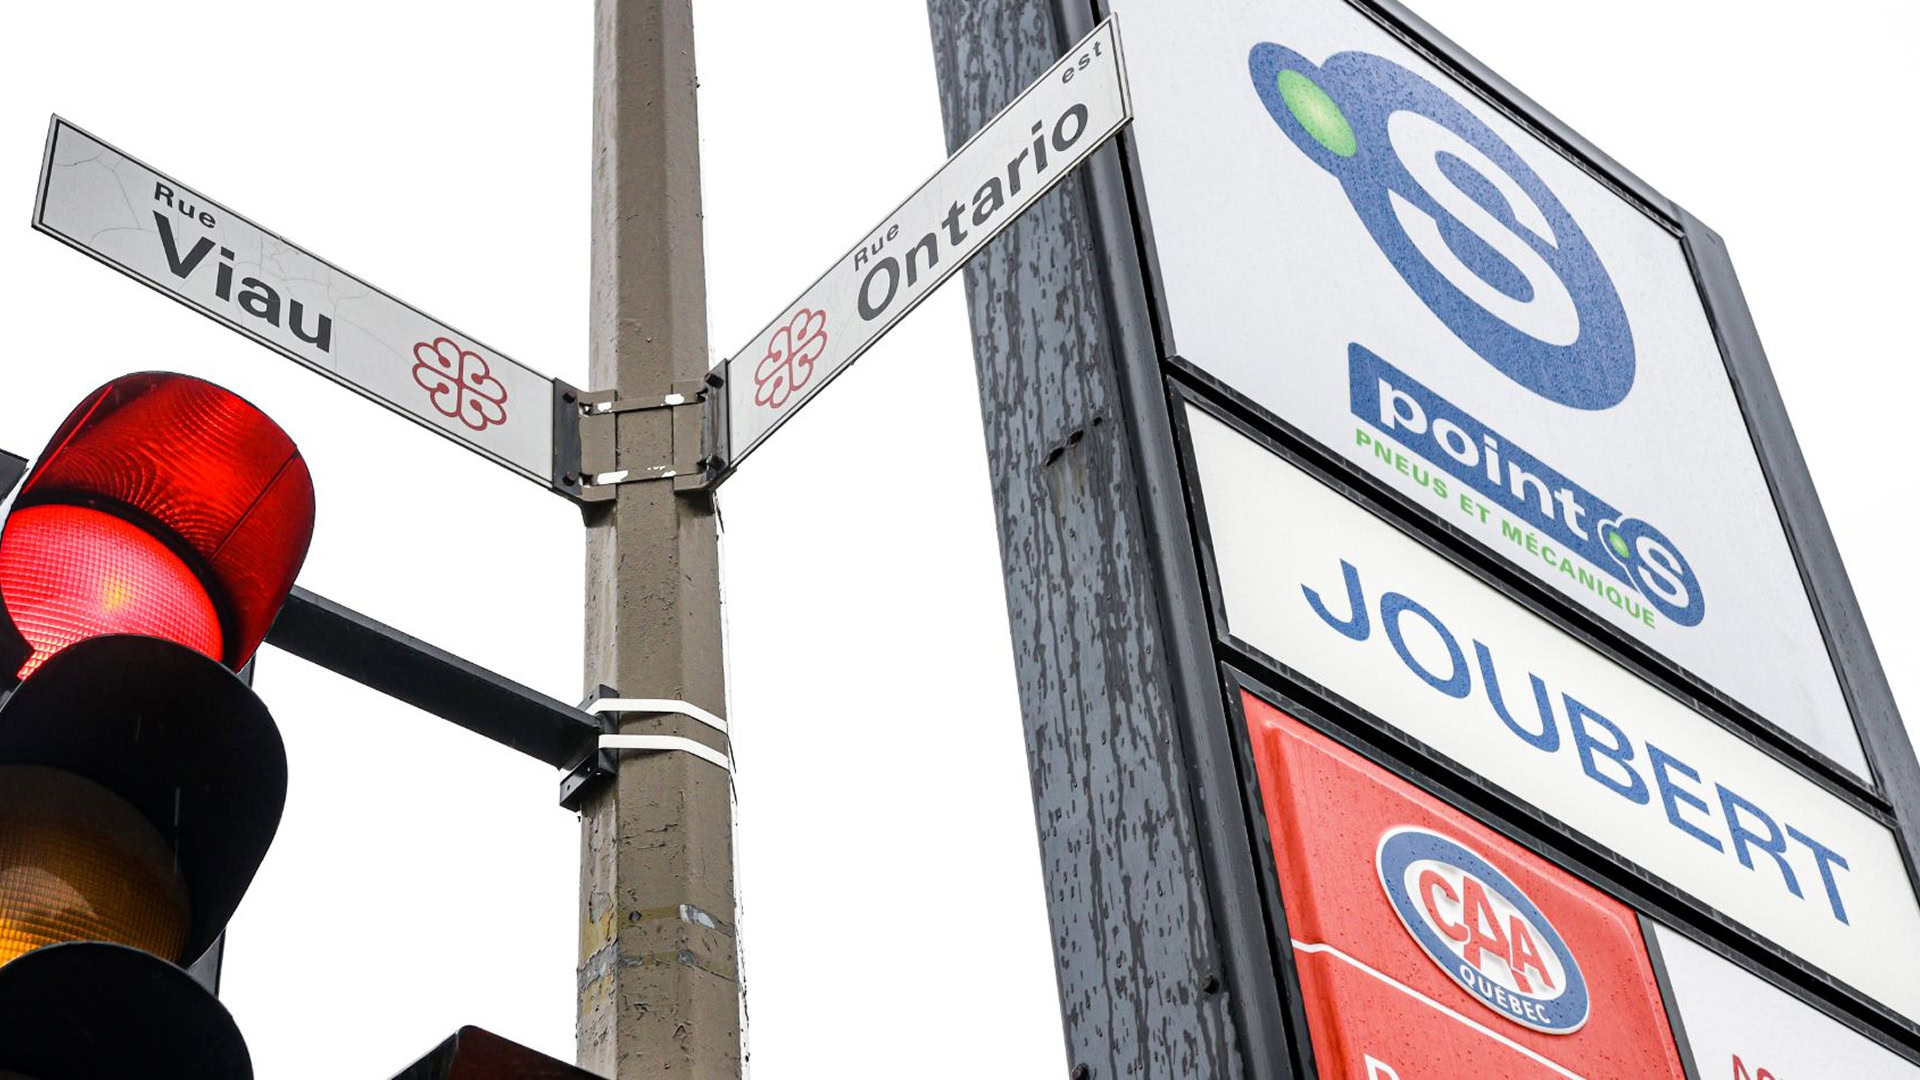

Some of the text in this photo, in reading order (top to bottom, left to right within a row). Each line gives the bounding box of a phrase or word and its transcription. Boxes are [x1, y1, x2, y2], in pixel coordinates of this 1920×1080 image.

[1062, 40, 1103, 85] est
[153, 181, 217, 228] Rue
[853, 223, 900, 272] Rue
[857, 103, 1089, 322] Ontario
[152, 210, 333, 354] Viau
[1378, 376, 1590, 541] point
[1355, 427, 1656, 630] PNEUS ET MÉCANIQUE
[1300, 557, 1850, 927] JOUBERT
[1418, 868, 1557, 997] CAA
[1458, 962, 1551, 1025] QUÉBEC
